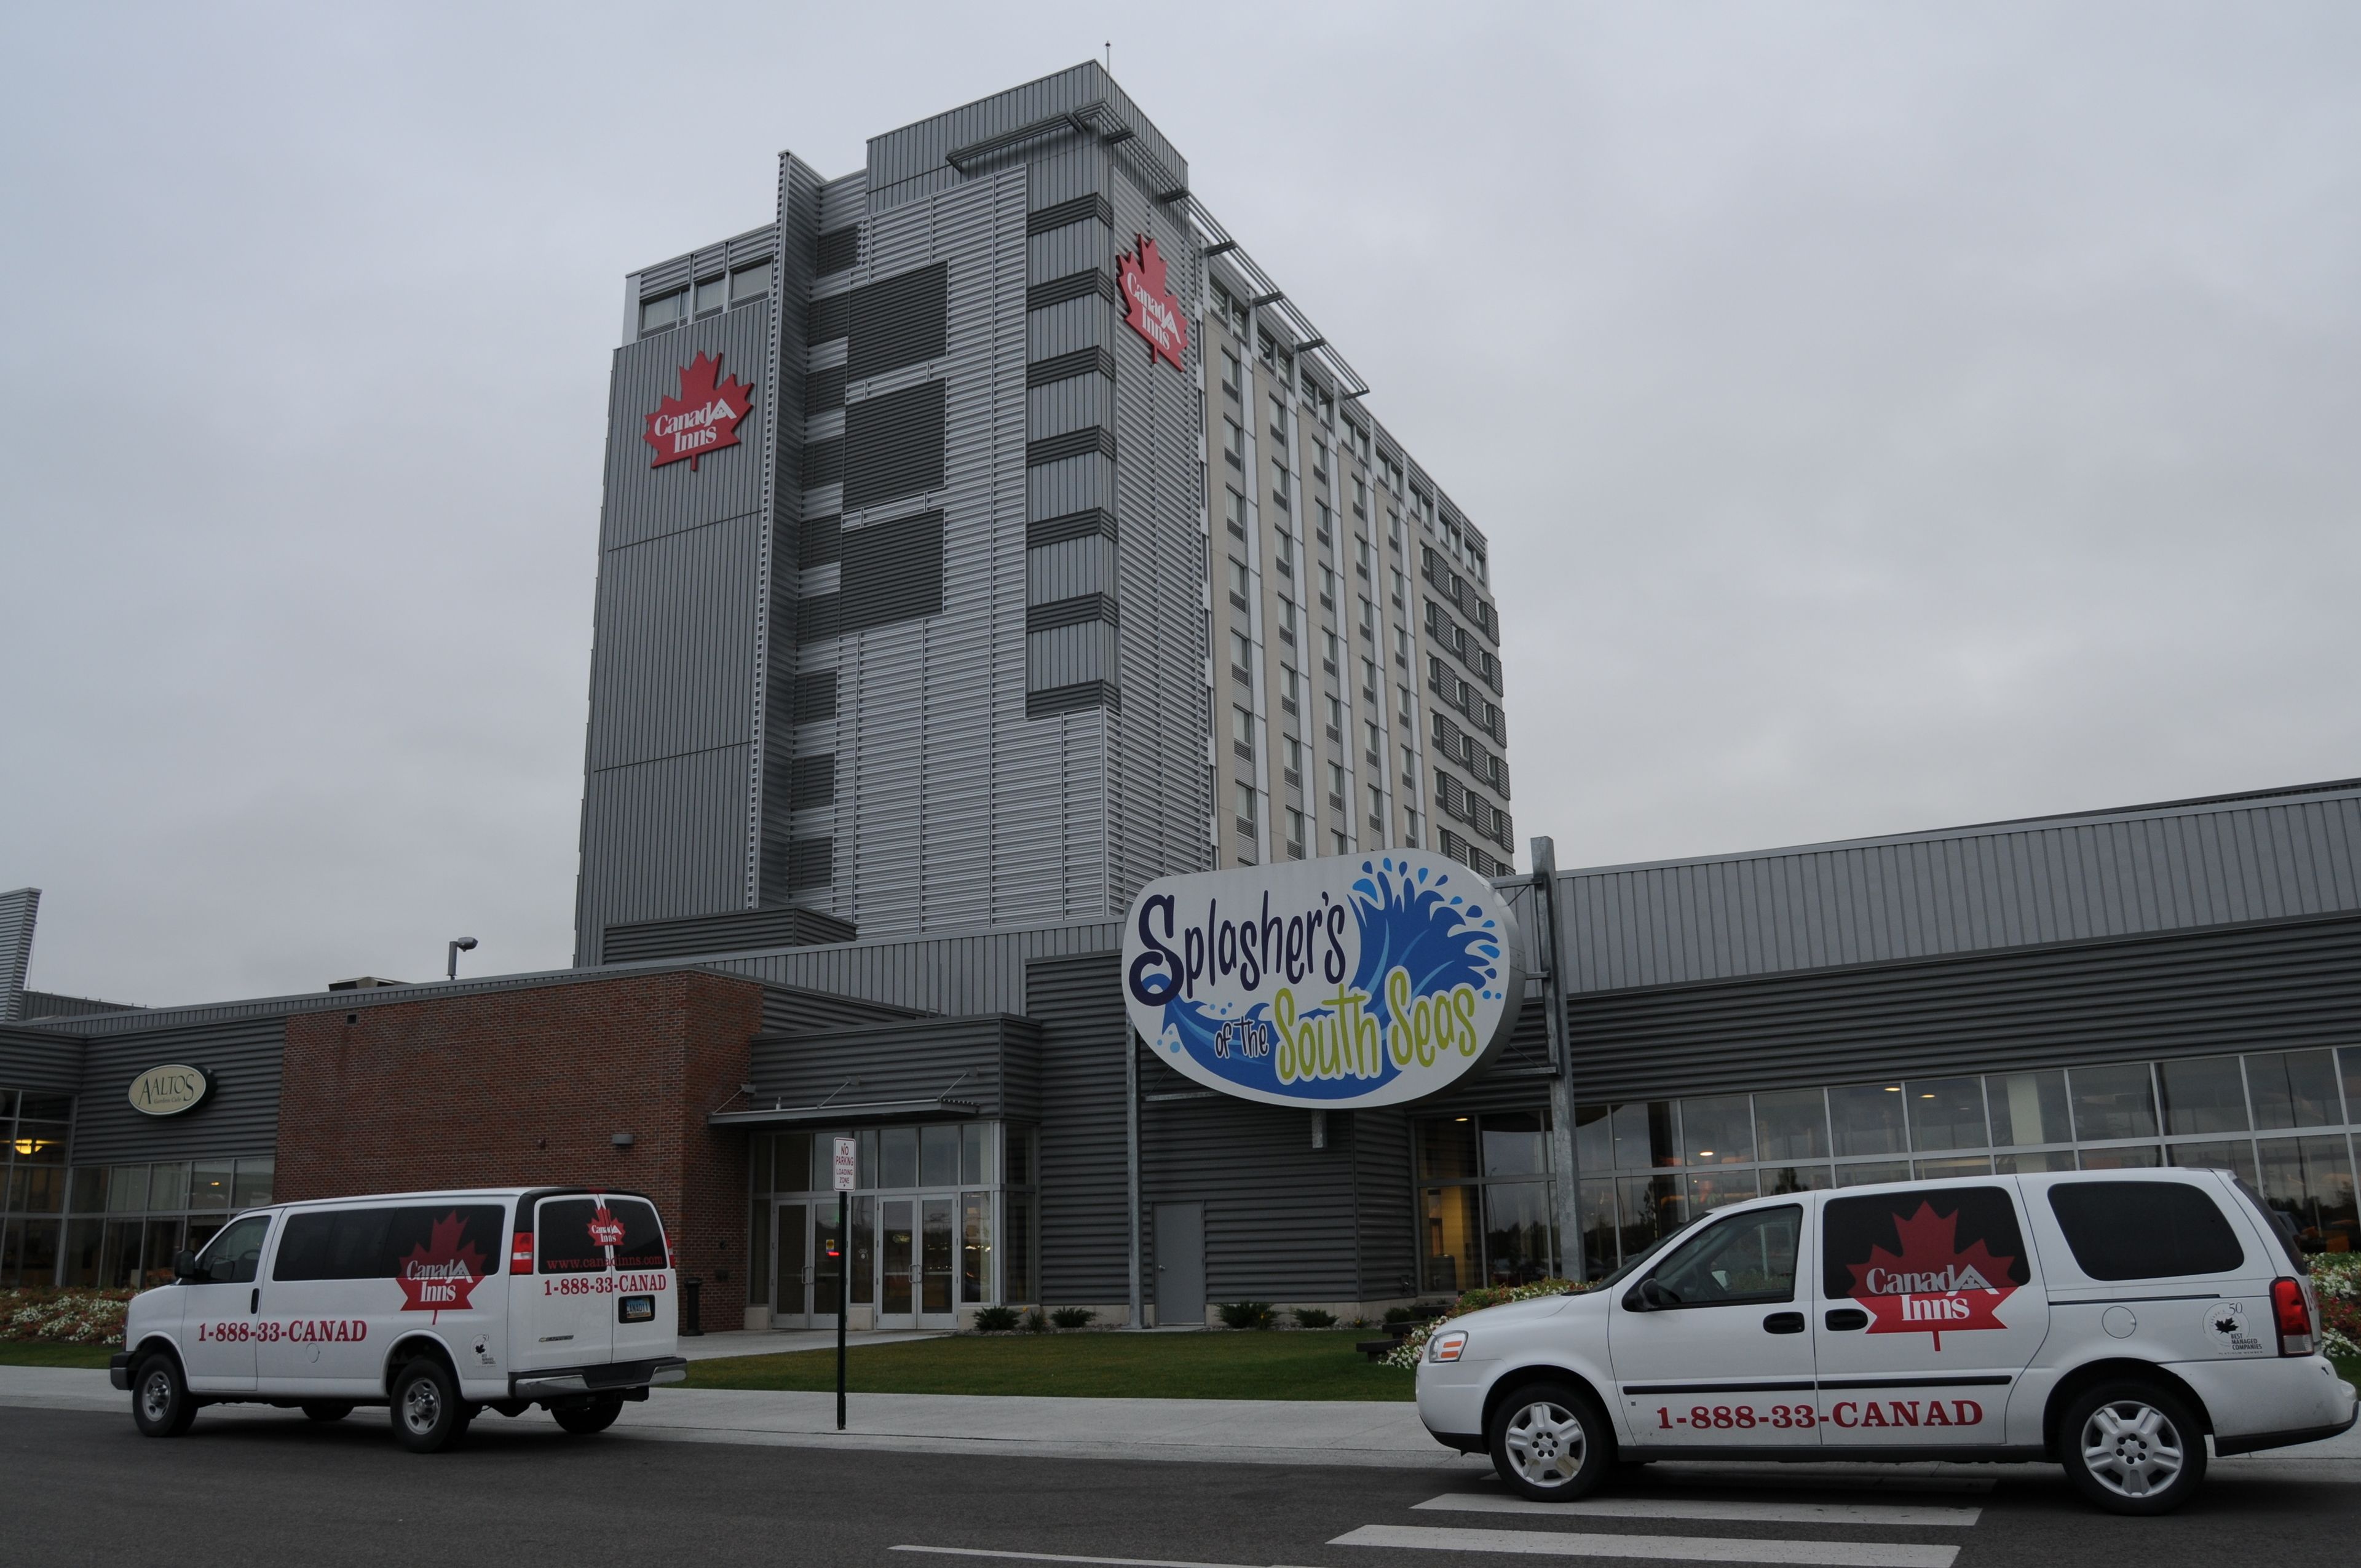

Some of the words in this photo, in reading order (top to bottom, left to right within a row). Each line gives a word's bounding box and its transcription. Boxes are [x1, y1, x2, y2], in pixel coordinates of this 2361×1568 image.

[1142, 305, 1170, 350] Inns
[673, 426, 717, 454] Inns
[1129, 890, 1346, 1007] Splasher's
[1215, 1022, 1232, 1059] of
[1235, 1015, 1268, 1058] the
[1275, 983, 1380, 1080] South
[1387, 970, 1477, 1068] Seas
[138, 1074, 194, 1106] AALTOS
[836, 1156, 853, 1166] PARKING
[840, 1146, 849, 1155] NO
[600, 1233, 617, 1243] Inns
[547, 1255, 663, 1270] www.canadinns.com
[420, 1281, 456, 1302] Inns
[544, 1274, 667, 1296] 1-888-33-CANAD
[1900, 1294, 1970, 1321] Inns
[2229, 1302, 2243, 1317] 50
[199, 1320, 367, 1342] 1-888-33-CANAD
[1656, 1400, 1983, 1429] 1-888-33-CANAD
